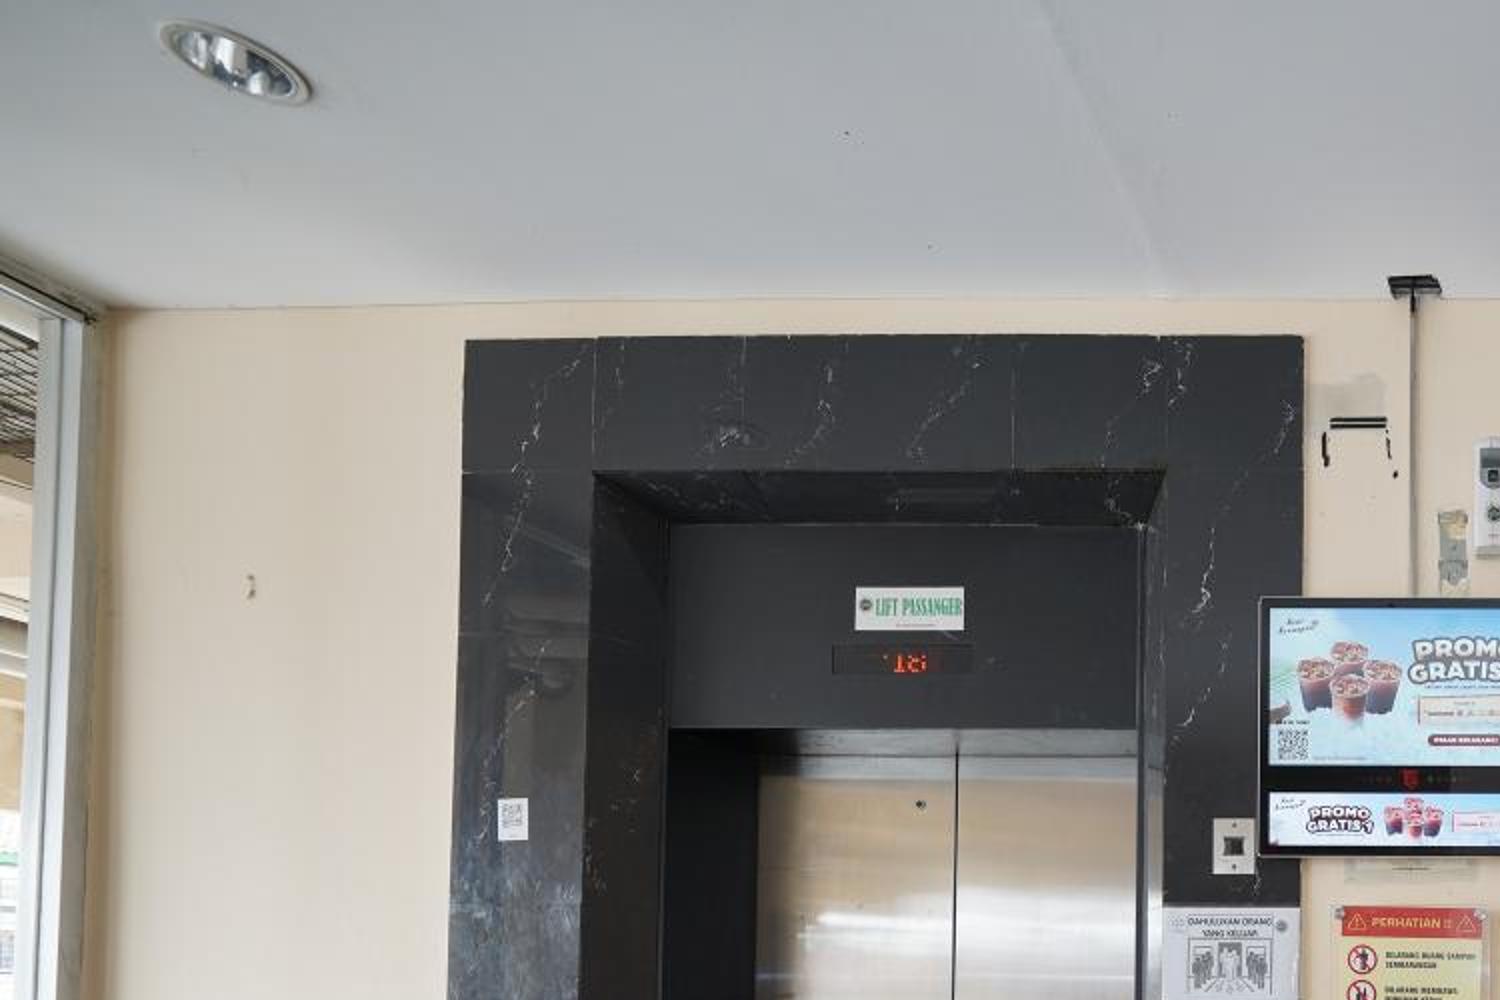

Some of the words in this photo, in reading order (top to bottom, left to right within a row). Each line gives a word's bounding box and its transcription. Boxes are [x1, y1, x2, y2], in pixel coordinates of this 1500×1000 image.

[875, 598, 898, 616] LIFT
[901, 598, 963, 616] PASSANGER
[1308, 805, 1371, 820] PROMO
[1306, 819, 1361, 833] GRATIS
[1371, 916, 1442, 930] PERHATIAN
